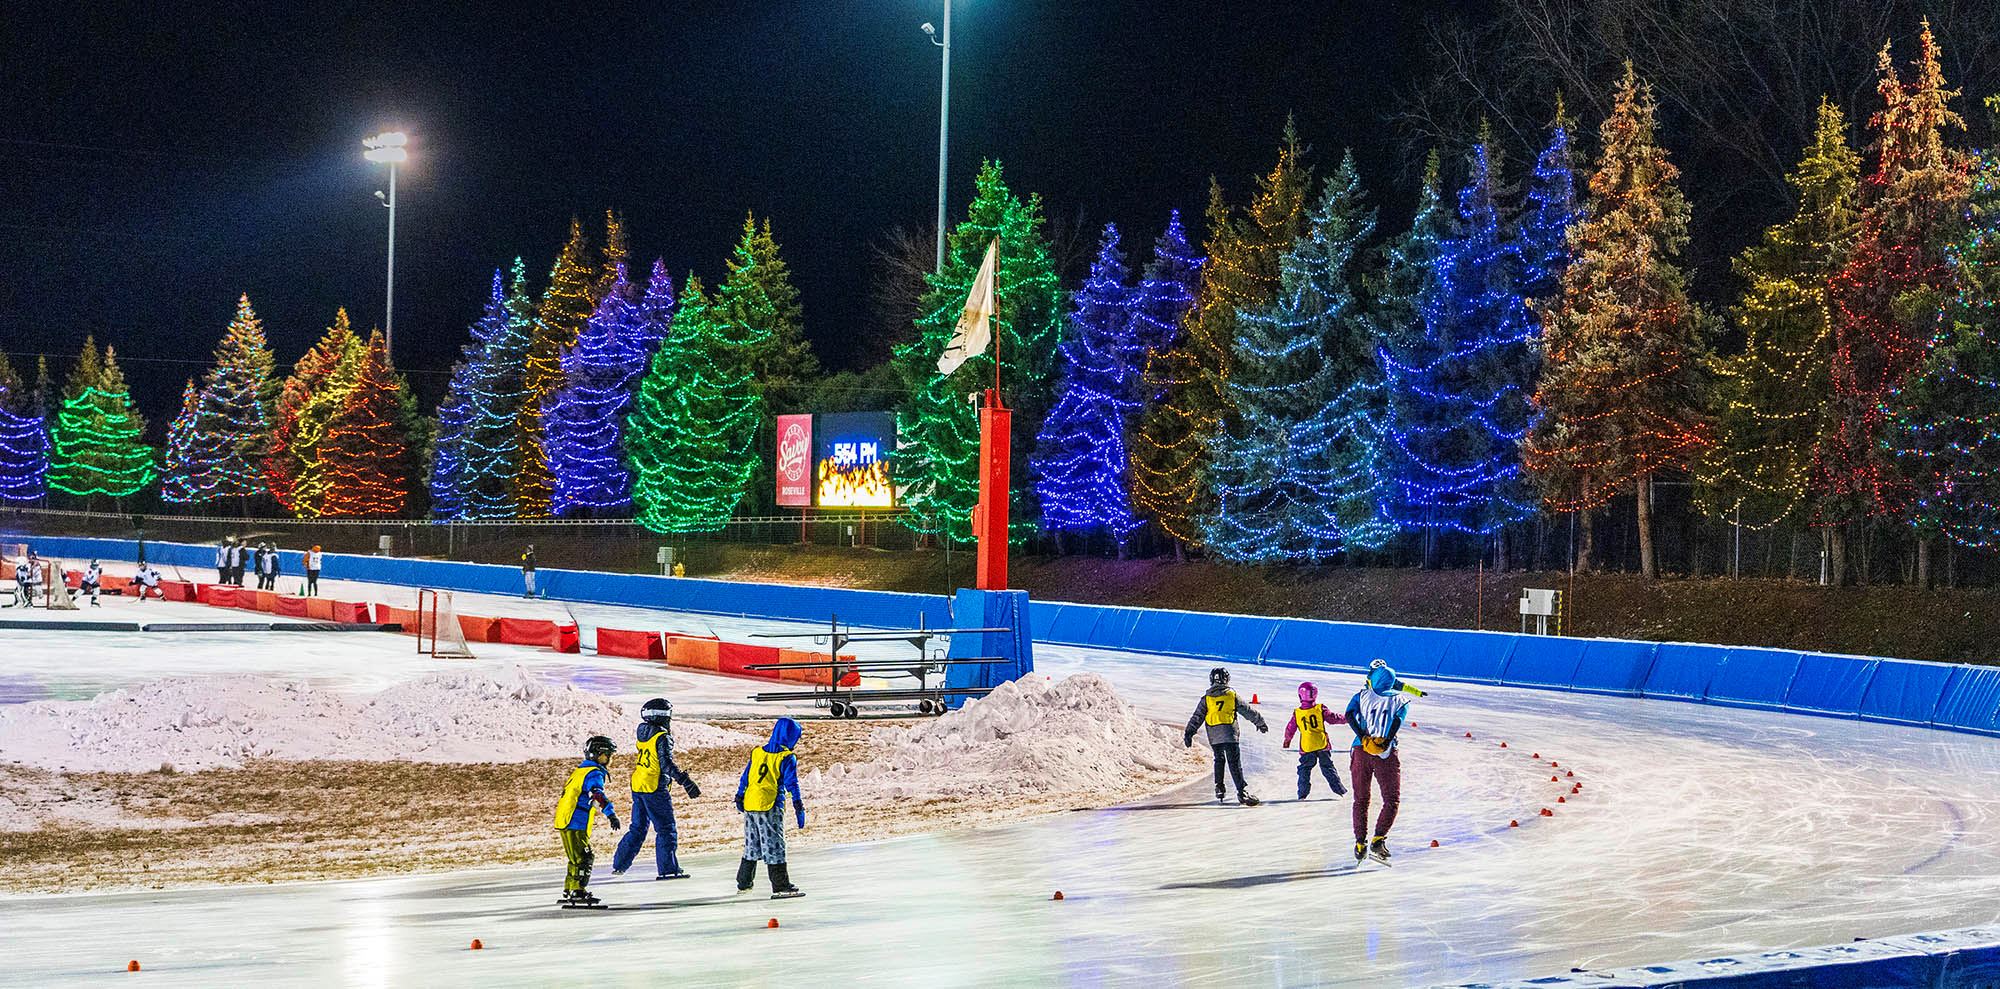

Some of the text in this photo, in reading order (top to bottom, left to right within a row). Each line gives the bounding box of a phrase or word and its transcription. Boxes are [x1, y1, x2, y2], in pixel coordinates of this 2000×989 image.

[860, 441, 877, 464] PM
[1215, 700, 1224, 711] 7
[1301, 714, 1318, 731] 10
[1370, 709, 1388, 728] 11
[637, 748, 650, 768] 23
[757, 762, 769, 784] 9
